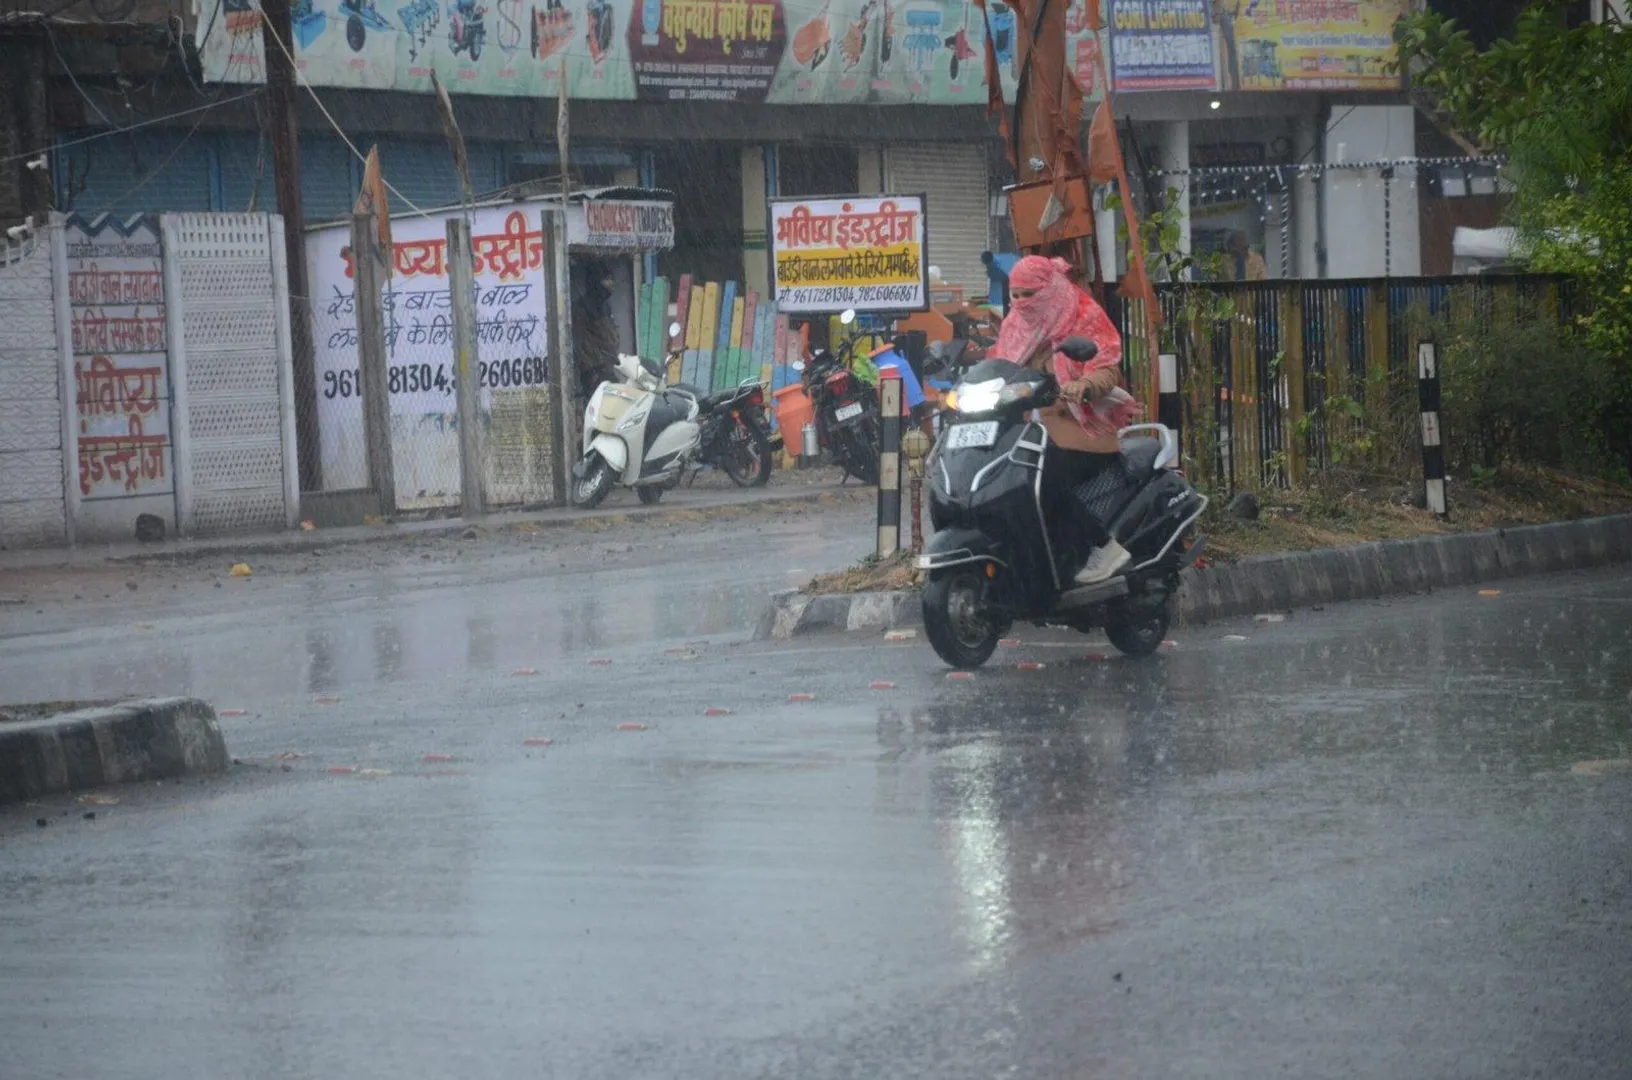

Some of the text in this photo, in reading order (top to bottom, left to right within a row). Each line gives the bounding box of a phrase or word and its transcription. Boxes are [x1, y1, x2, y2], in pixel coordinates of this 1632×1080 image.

[637, 205, 673, 234] TRADERS
[777, 201, 917, 250] भविष्य इंडस्ट्रीज
